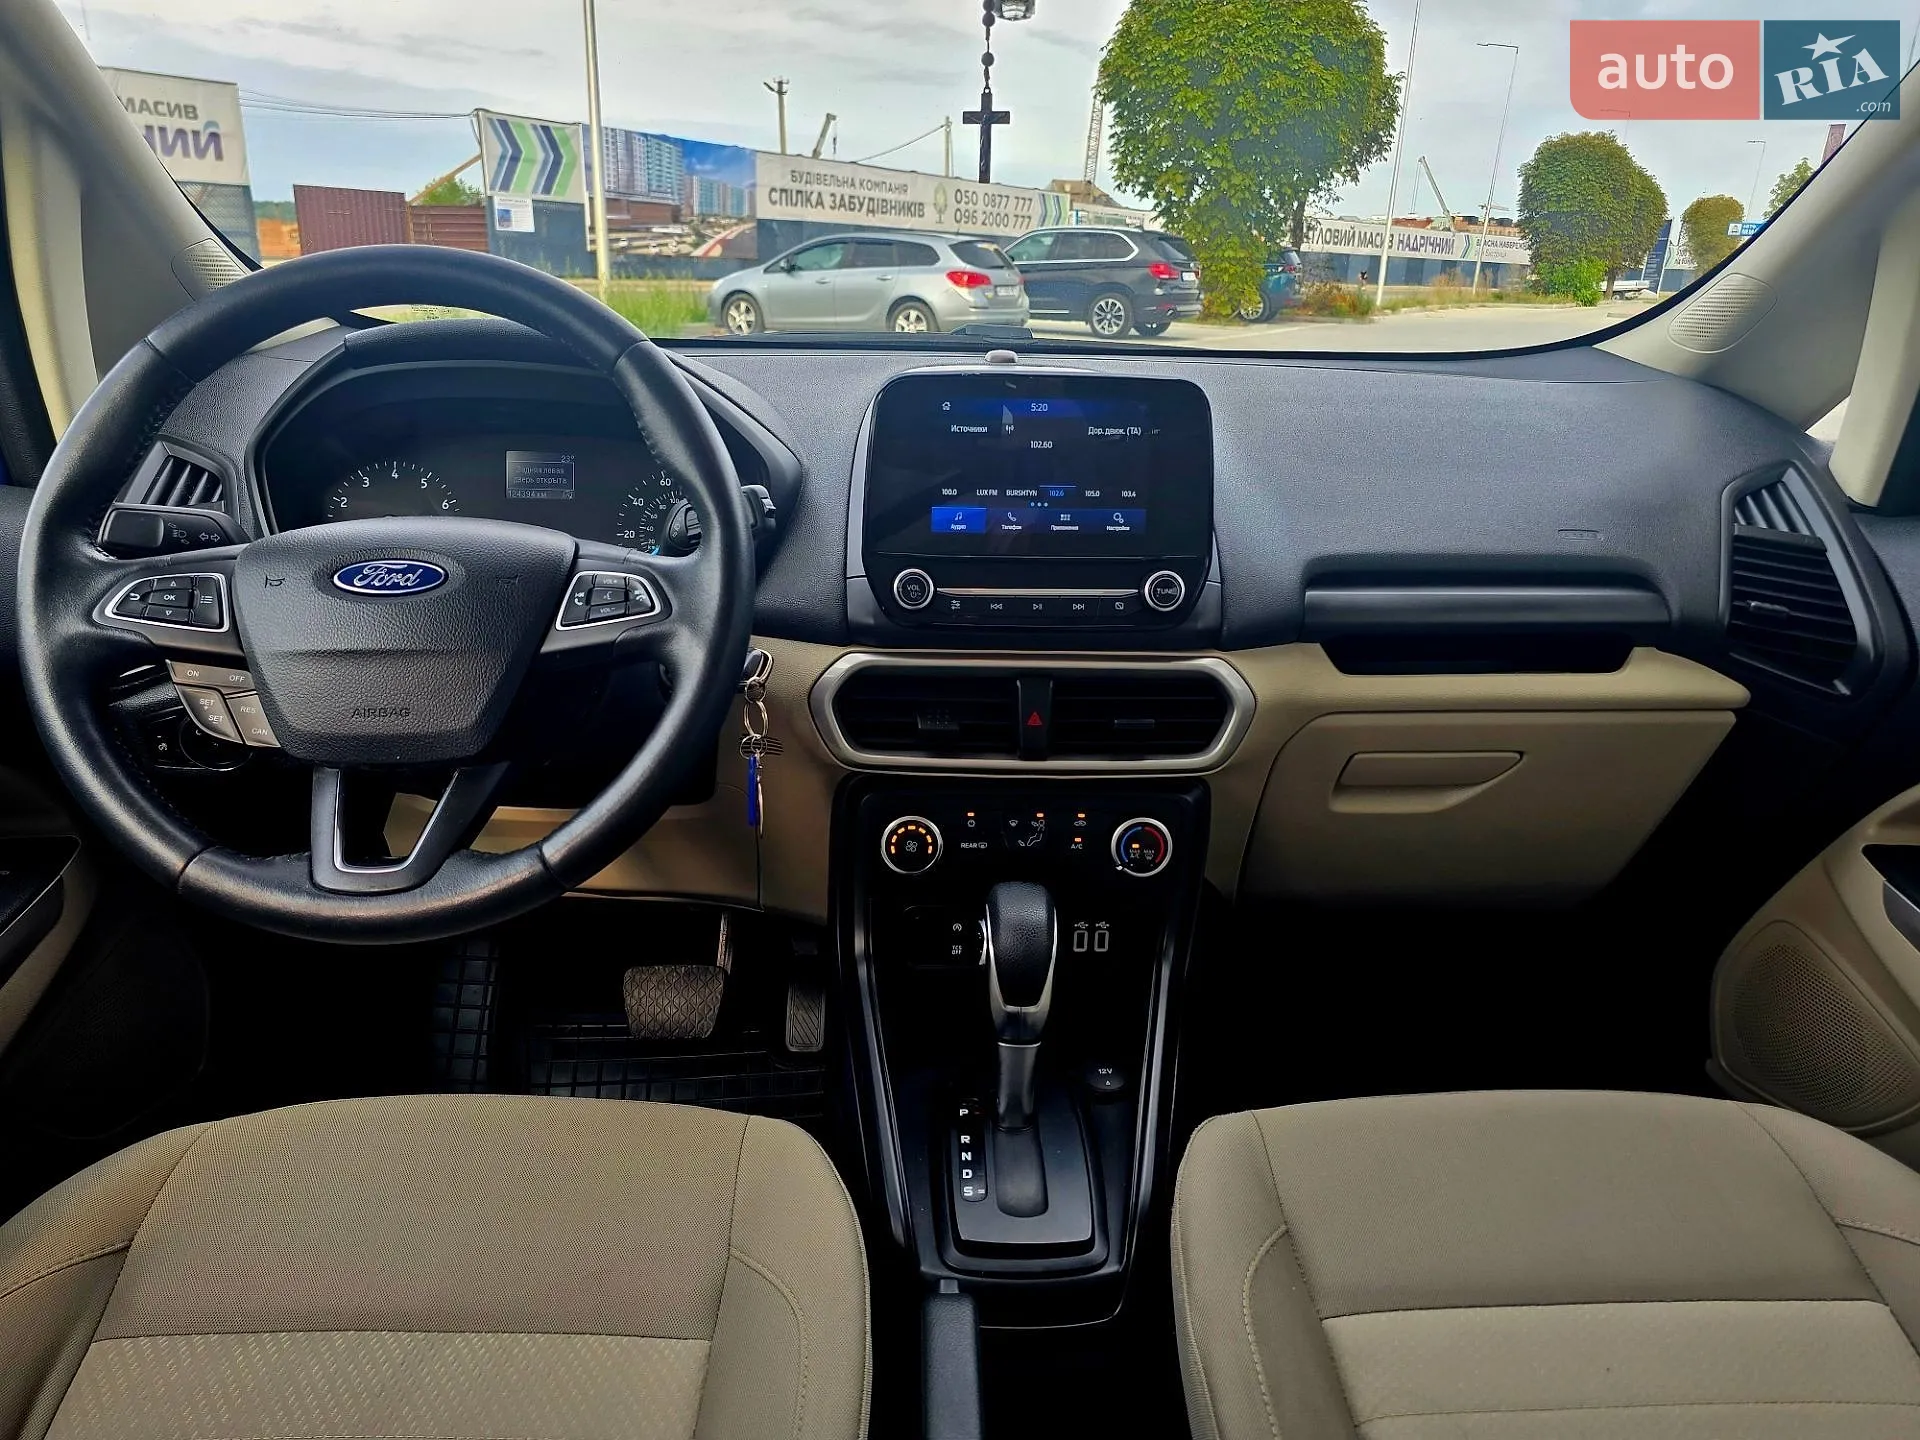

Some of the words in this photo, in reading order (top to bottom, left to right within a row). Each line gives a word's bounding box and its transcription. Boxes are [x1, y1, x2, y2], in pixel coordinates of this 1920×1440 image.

[144, 120, 224, 161] ИЙ
[790, 169, 857, 191] БУДІВЕЛЬНА
[859, 180, 909, 196] КОМПАНІЯ
[768, 187, 825, 210] СПІЛКА
[829, 192, 926, 219] ЗАБУДІВНИКІВ
[953, 188, 978, 206] 050
[982, 191, 1009, 211] 0877
[1014, 194, 1033, 213] 777
[953, 208, 978, 226] 096
[981, 210, 1010, 229] 2000
[1012, 213, 1032, 231] 777
[1030, 402, 1048, 412] 5:20
[950, 424, 988, 433] Источники
[1030, 440, 1053, 449] 102.60
[391, 469, 399, 479] 4
[362, 477, 370, 488] 3
[420, 478, 428, 489] 5
[659, 478, 672, 487] 60
[941, 488, 958, 496] 100.0
[976, 488, 988, 496] LUX
[1006, 489, 1038, 497] BURSHTYN
[1049, 489, 1065, 497] 102.6
[340, 496, 348, 508] 2
[441, 499, 449, 510] 6
[632, 498, 644, 506] 40
[623, 530, 636, 539] 20
[353, 562, 422, 588] Ford
[187, 669, 200, 677] ON
[229, 674, 246, 683] OFF
[199, 698, 215, 706] SET
[240, 705, 256, 714] RES
[350, 706, 411, 720] AIRBAG
[208, 714, 224, 722] SET
[251, 727, 268, 736] CAN
[1098, 1067, 1113, 1075] 12V
[959, 1108, 969, 1117] P
[960, 1135, 971, 1144] R
[961, 1151, 972, 1161] N
[962, 1169, 973, 1179] D
[963, 1187, 973, 1197] S
